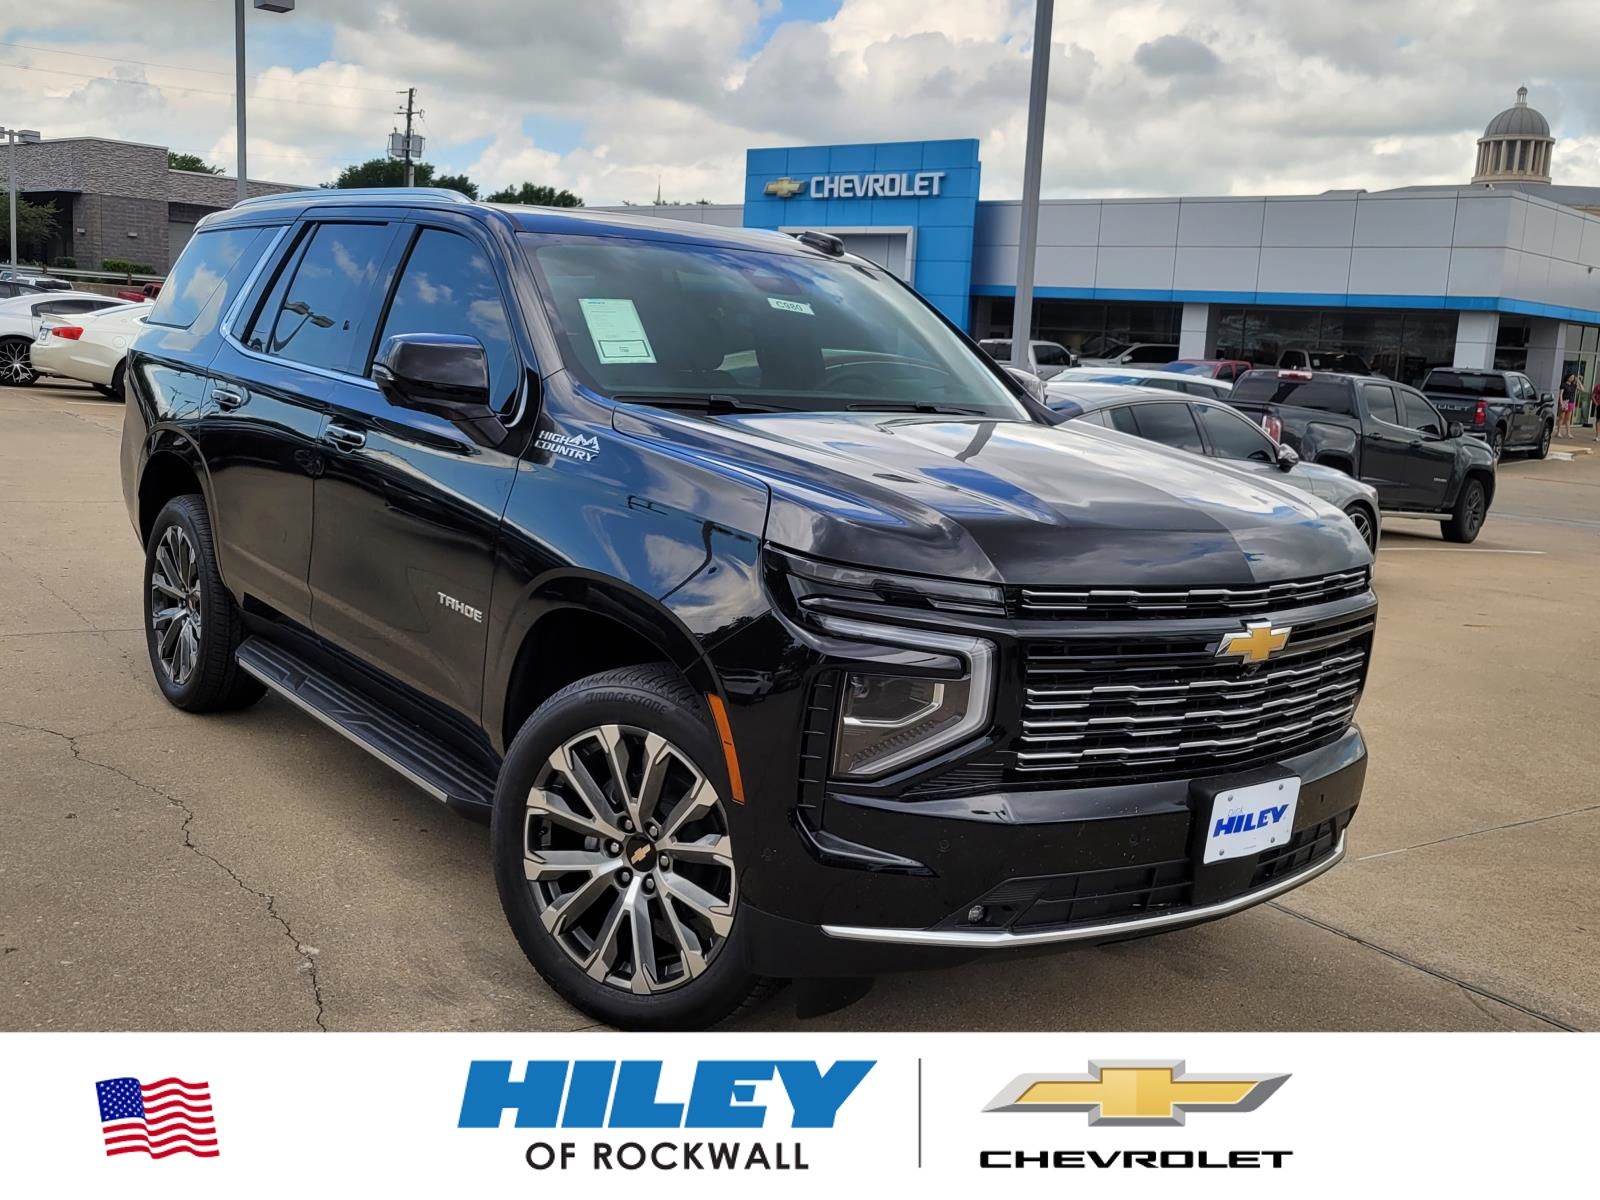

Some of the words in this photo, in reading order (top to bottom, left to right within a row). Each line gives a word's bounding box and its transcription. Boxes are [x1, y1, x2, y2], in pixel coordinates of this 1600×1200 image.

[810, 172, 945, 199] CHEVROLET
[539, 429, 571, 445] HIGH
[534, 440, 598, 462] COUNTRY
[437, 591, 483, 623] TAHOE
[584, 691, 669, 714] BRIDGESTONE
[1213, 804, 1289, 837] HILEY
